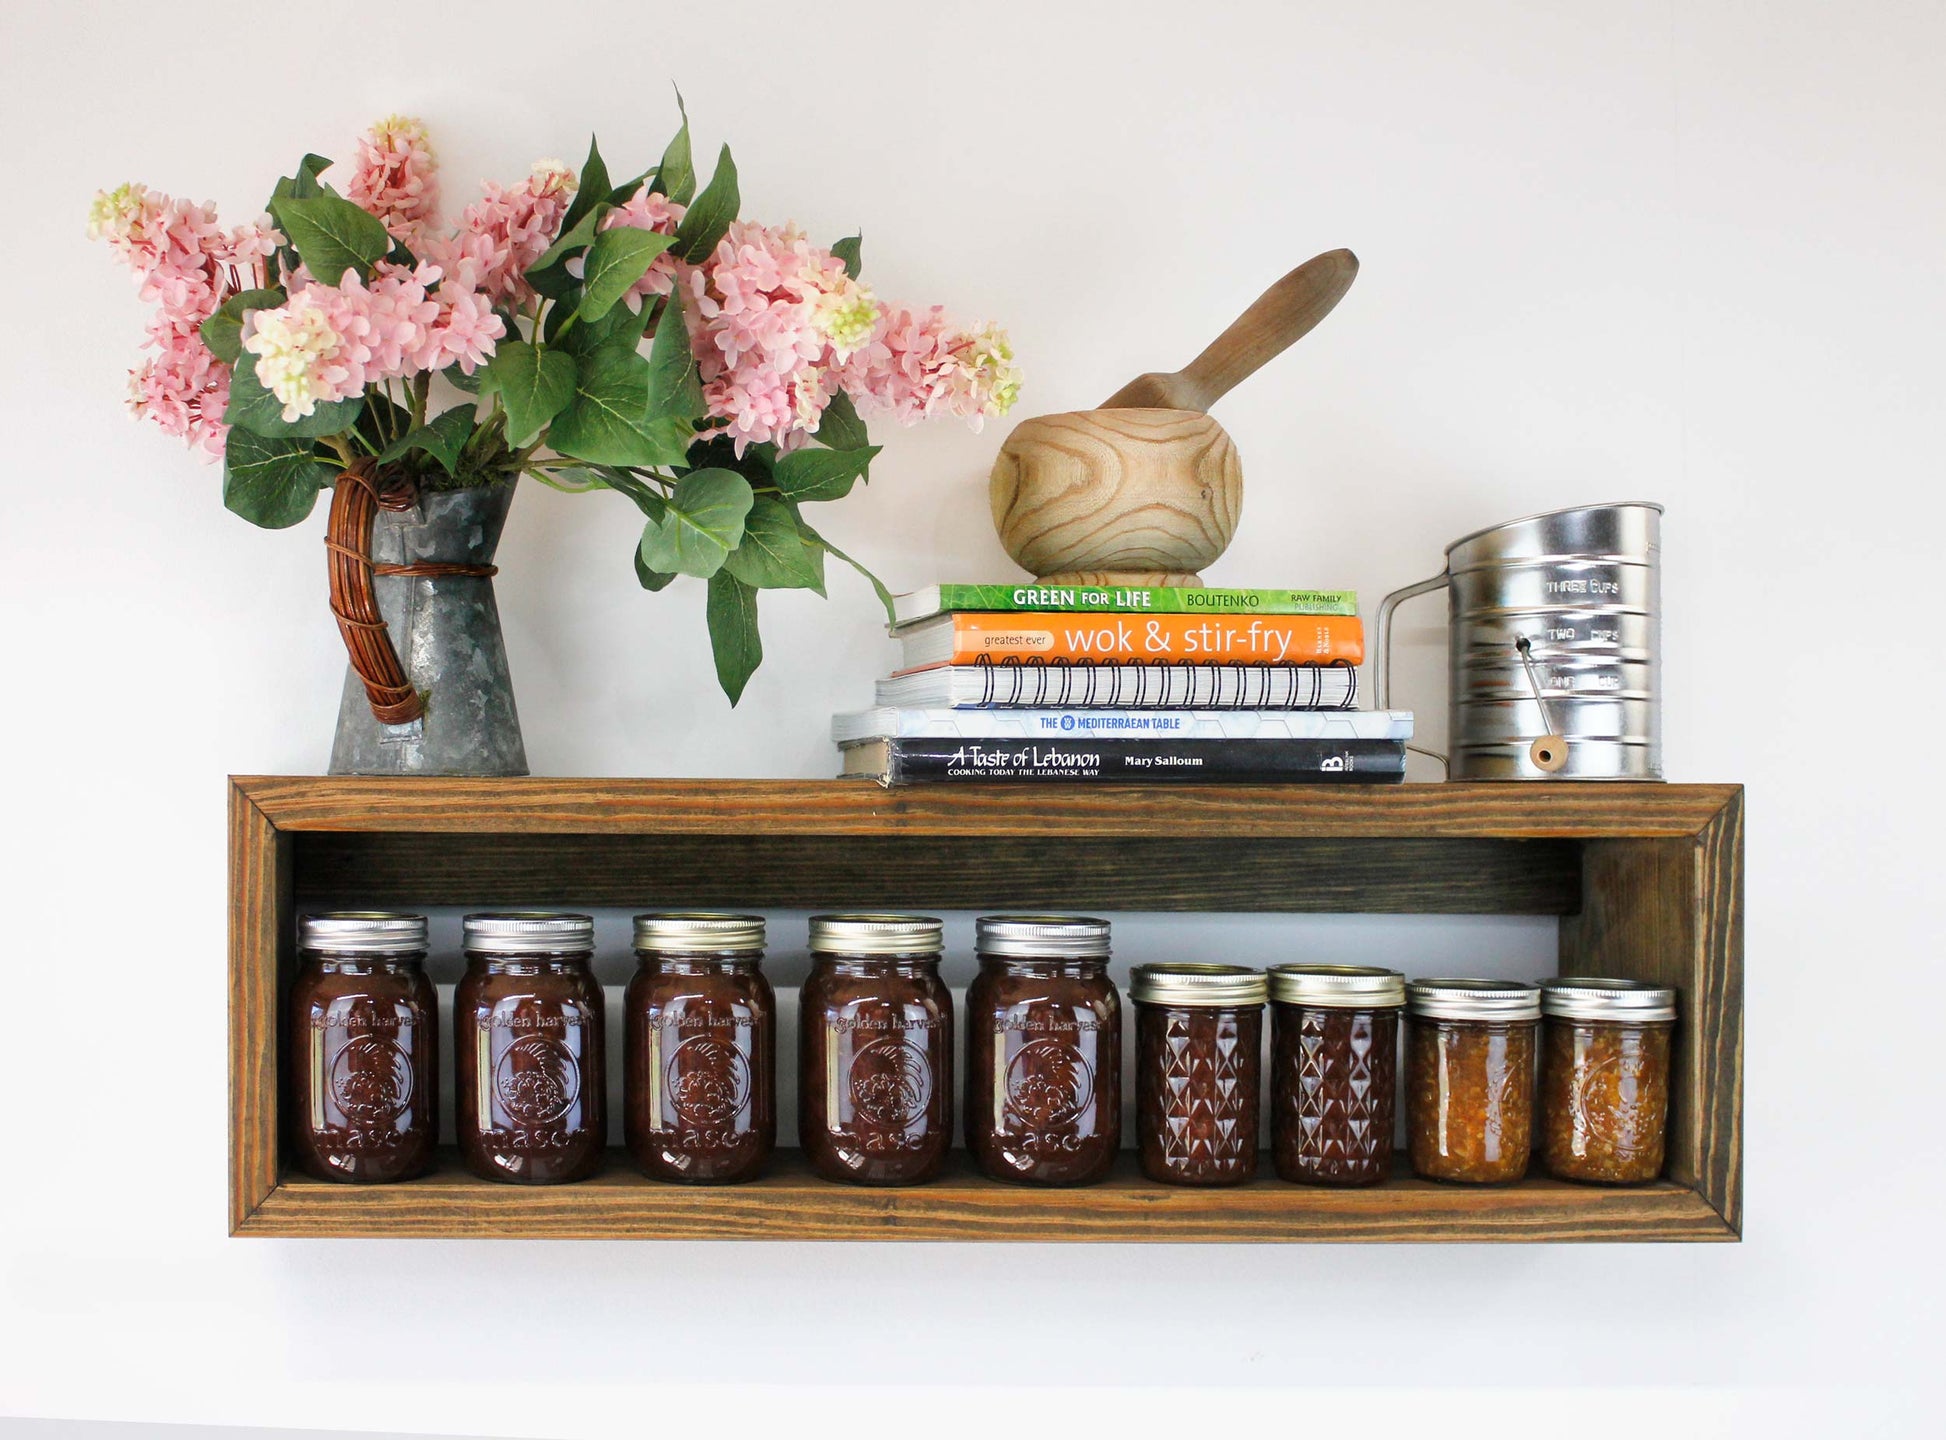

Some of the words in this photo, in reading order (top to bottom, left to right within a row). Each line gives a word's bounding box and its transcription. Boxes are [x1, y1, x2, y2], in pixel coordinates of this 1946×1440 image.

[1547, 580, 1587, 593] THREE
[1590, 579, 1619, 594] CUPS
[1013, 589, 1075, 606] GREEN
[1081, 592, 1110, 605] FOR
[1116, 591, 1151, 607] LIFE
[1187, 593, 1260, 607] BOUTENKO
[1291, 594, 1310, 602] RAW
[1294, 603, 1338, 611] PUBLISHING
[1548, 627, 1576, 640] TWO
[984, 635, 1023, 648] greatest
[1025, 636, 1046, 645] ever
[1065, 620, 1133, 652] wok
[1145, 620, 1171, 653] &
[1184, 621, 1292, 662] stir-fry
[1040, 717, 1058, 729] THE
[1077, 717, 1150, 729] MEDITERRAEAN
[1151, 718, 1181, 730] TABLE
[947, 745, 965, 767] A
[968, 745, 1010, 767] Taste
[1012, 746, 1030, 767] of
[1033, 745, 1100, 767] Lebanon
[1125, 756, 1153, 768] Mary
[1154, 756, 1203, 766] Salloum
[947, 768, 986, 776] COOKING
[989, 768, 1015, 776] TODAY
[1018, 768, 1034, 776] THE
[1037, 768, 1080, 776] LEBANESE
[1082, 768, 1100, 776] WAY
[1048, 1014, 1100, 1032] harves
